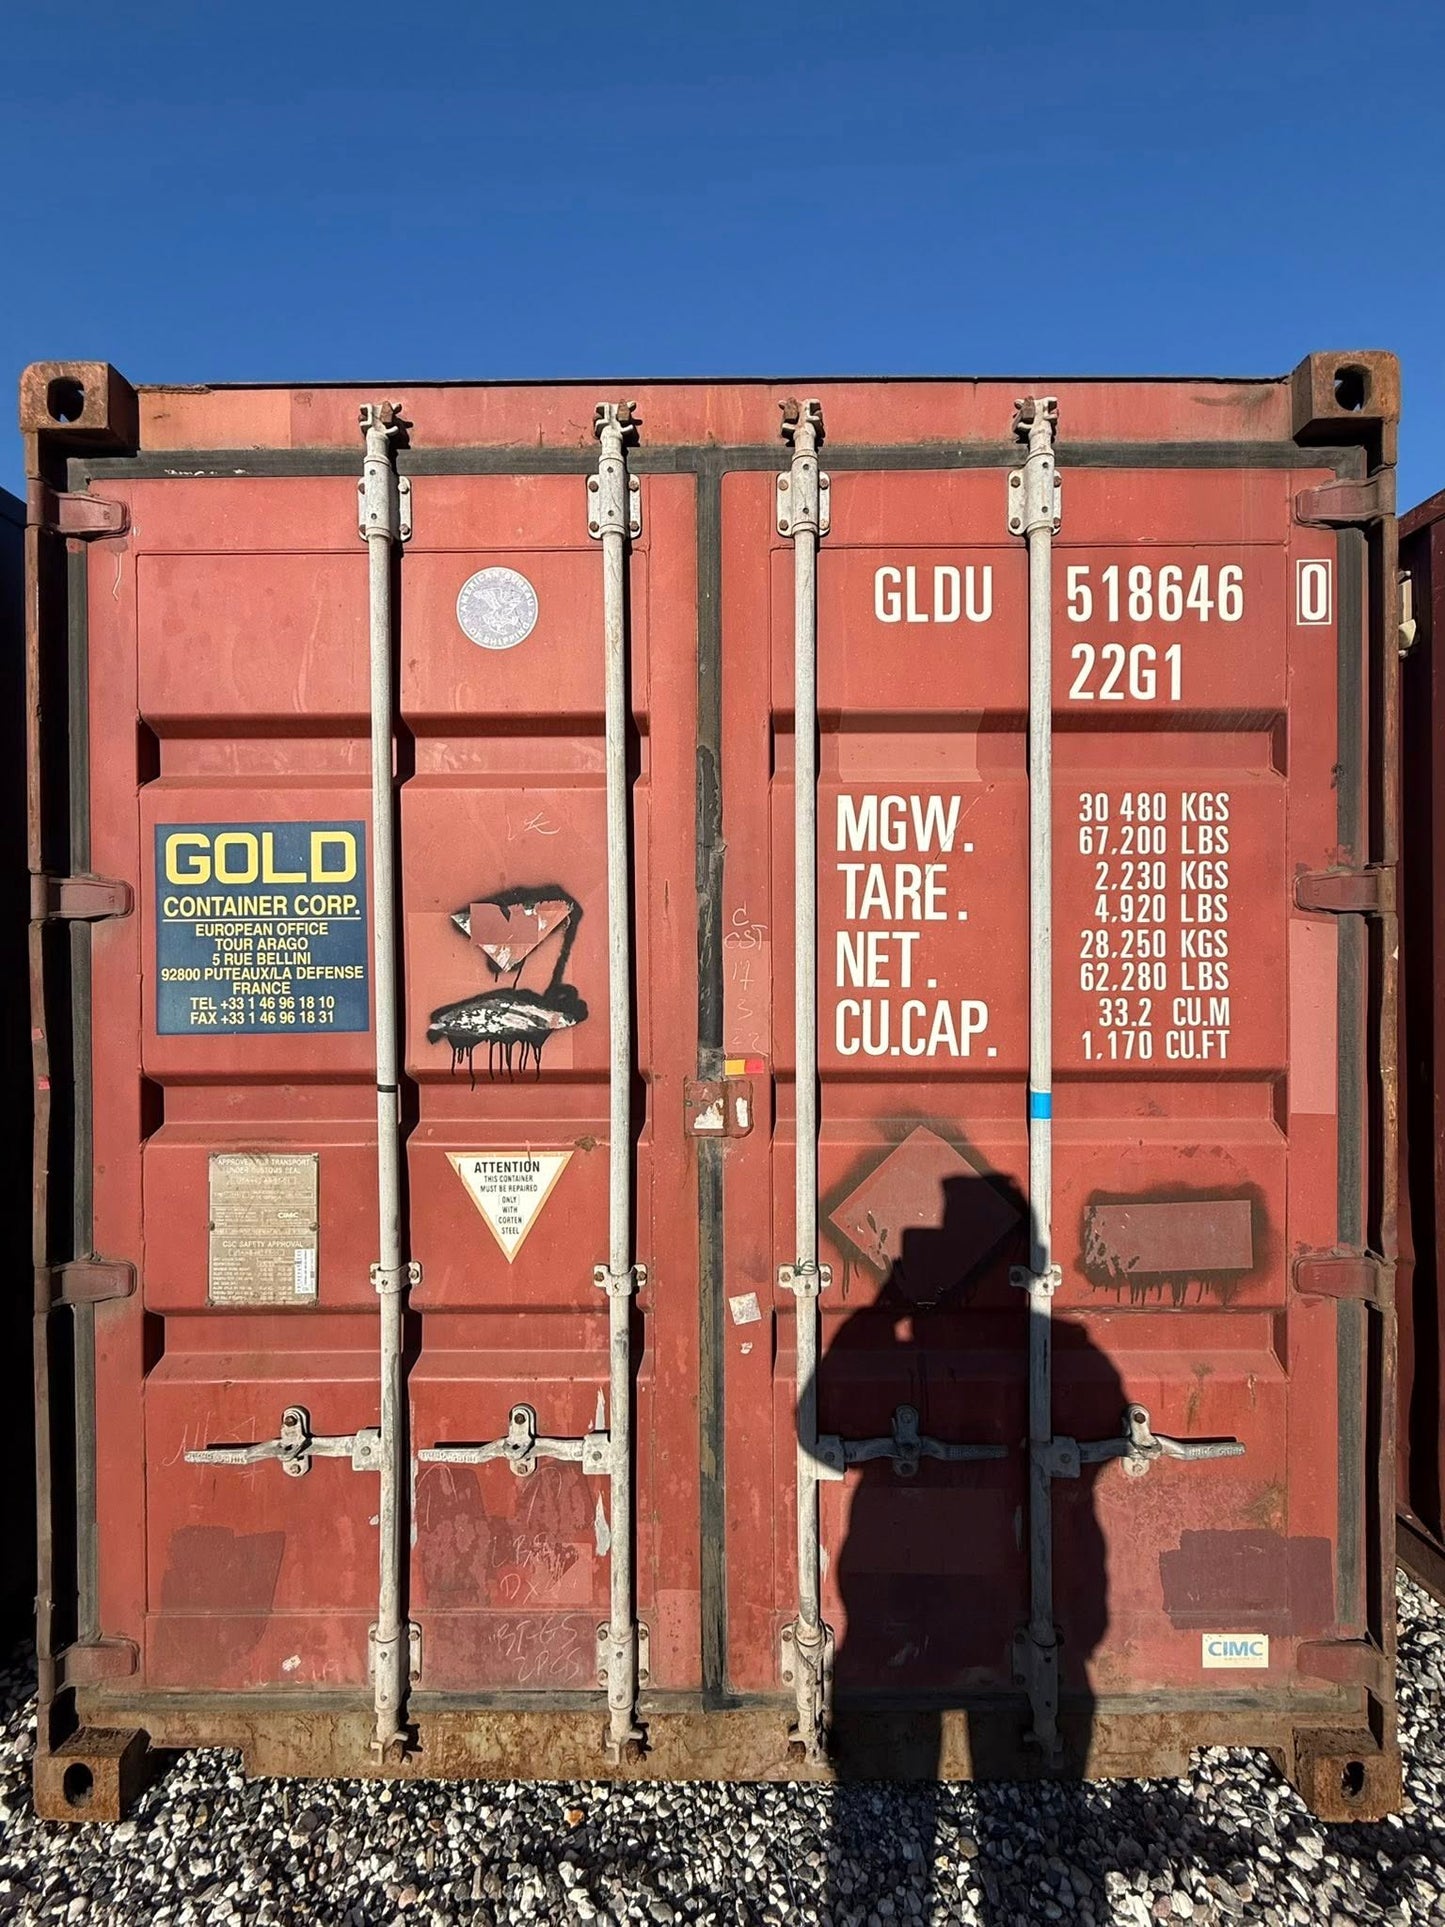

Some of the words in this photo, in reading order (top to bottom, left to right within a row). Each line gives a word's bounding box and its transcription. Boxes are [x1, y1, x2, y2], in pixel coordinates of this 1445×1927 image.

[874, 566, 992, 622] GLDU
[1067, 564, 1244, 622] 518646
[1069, 643, 1181, 700] 22G1
[1079, 792, 1109, 822] 30
[1120, 792, 1166, 822] 480
[1182, 792, 1229, 822] KGS
[837, 795, 974, 852] MGW.
[1079, 826, 1166, 855] 67,200
[1182, 826, 1229, 855] LBS
[166, 831, 356, 884] GOLD
[1095, 861, 1166, 891] 2,230
[1181, 860, 1229, 890] KGS
[164, 896, 287, 917] CONTAINER
[294, 895, 360, 916] CORP.
[1095, 894, 1166, 923] 4,920
[1181, 894, 1228, 923] LBS
[196, 924, 272, 936] EUROPEAN
[277, 923, 328, 935] OFFICE
[215, 938, 253, 950] TOUR
[257, 938, 308, 950] ARAGO
[1080, 929, 1166, 958] 28,250
[1181, 929, 1228, 958] KGS
[161, 968, 200, 981] 92800
[205, 967, 292, 980] PUTEAUX/LA
[296, 966, 363, 979] DEFENSE
[212, 954, 220, 965] 5
[225, 953, 252, 965] RUE
[257, 953, 311, 965] BELLINI
[233, 982, 291, 994] FRANCE
[1080, 962, 1166, 991] 62,280
[1182, 962, 1229, 991] LBS
[190, 997, 217, 1010] TEL
[221, 997, 244, 1009] +33
[249, 997, 255, 1009] 1
[260, 997, 275, 1009] 46
[279, 997, 294, 1009] 96
[300, 997, 314, 1009] 18
[319, 996, 334, 1008] 10
[190, 1012, 217, 1024] FAX
[221, 1012, 244, 1024] +33
[249, 1012, 255, 1024] 1
[260, 1012, 275, 1024] 46
[280, 1011, 295, 1023] 96
[301, 1011, 314, 1023] 18
[319, 1011, 334, 1023] 31
[1099, 998, 1151, 1026] 33.2
[1173, 997, 1230, 1026] CU.M
[836, 999, 997, 1056] CU.CAP.
[1082, 1030, 1152, 1059] 1,170
[1166, 1030, 1230, 1059] CU.FT
[474, 1161, 540, 1173] ATTENTION
[1208, 1642, 1263, 1656] CIMC
